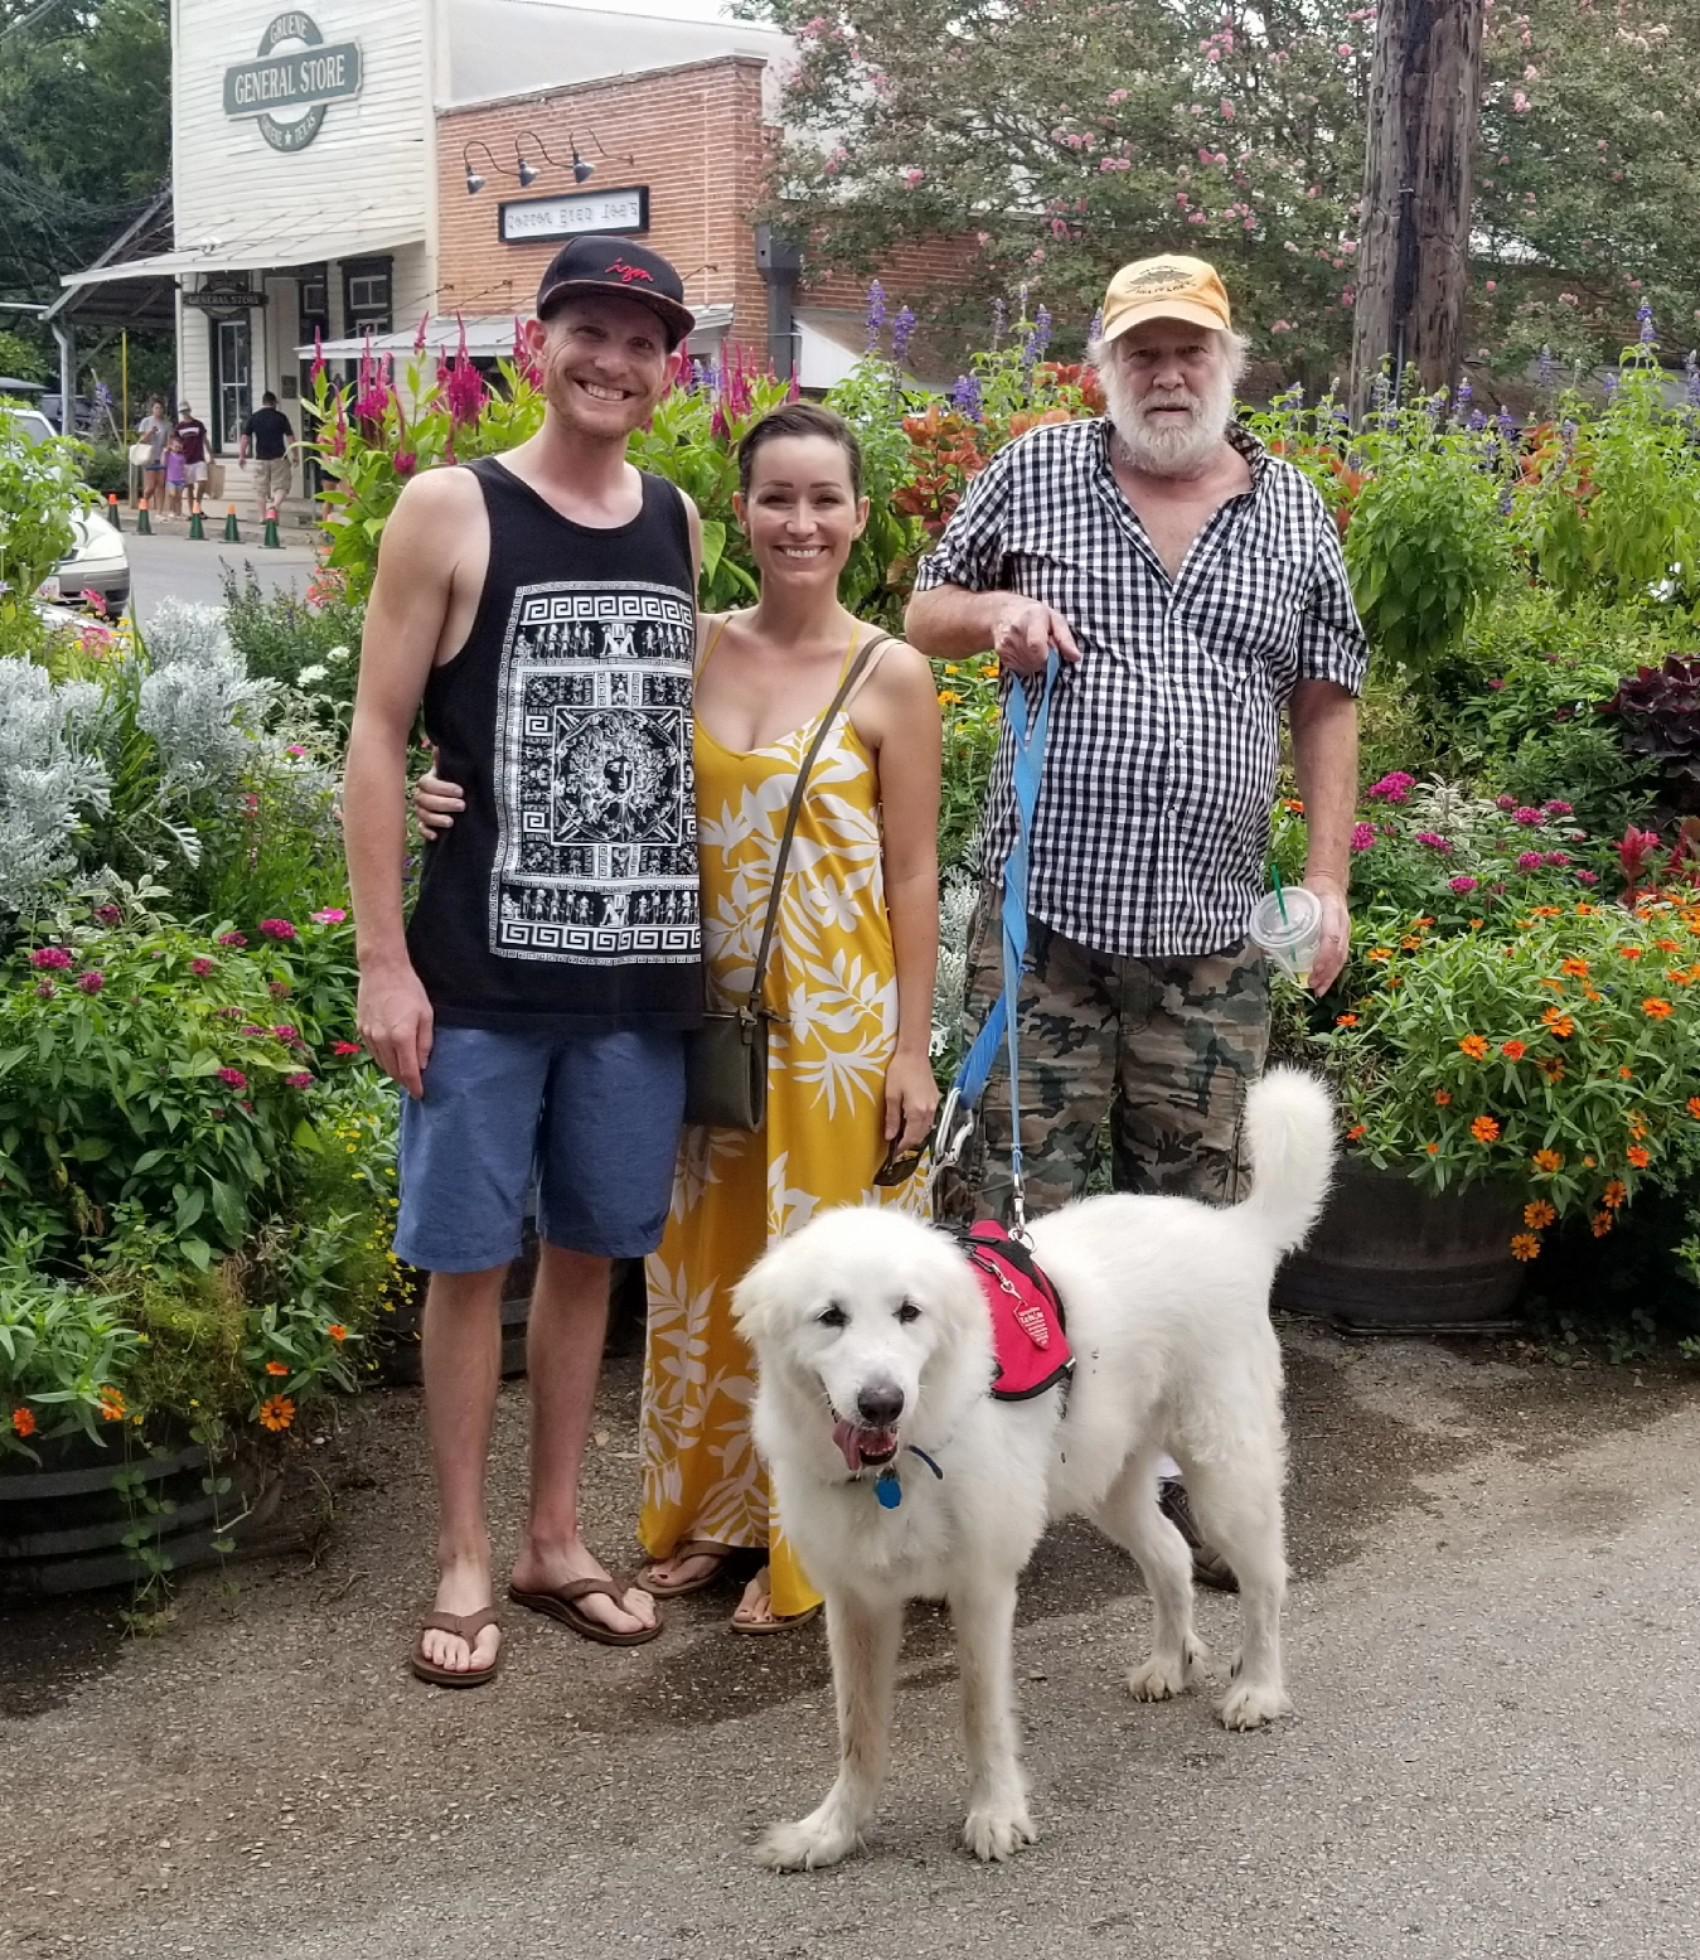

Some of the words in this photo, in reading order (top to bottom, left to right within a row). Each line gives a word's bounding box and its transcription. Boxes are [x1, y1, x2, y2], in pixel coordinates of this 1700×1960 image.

[270, 15, 308, 43] GRUENE
[235, 65, 296, 105] GENERAL
[300, 54, 345, 93] STORE
